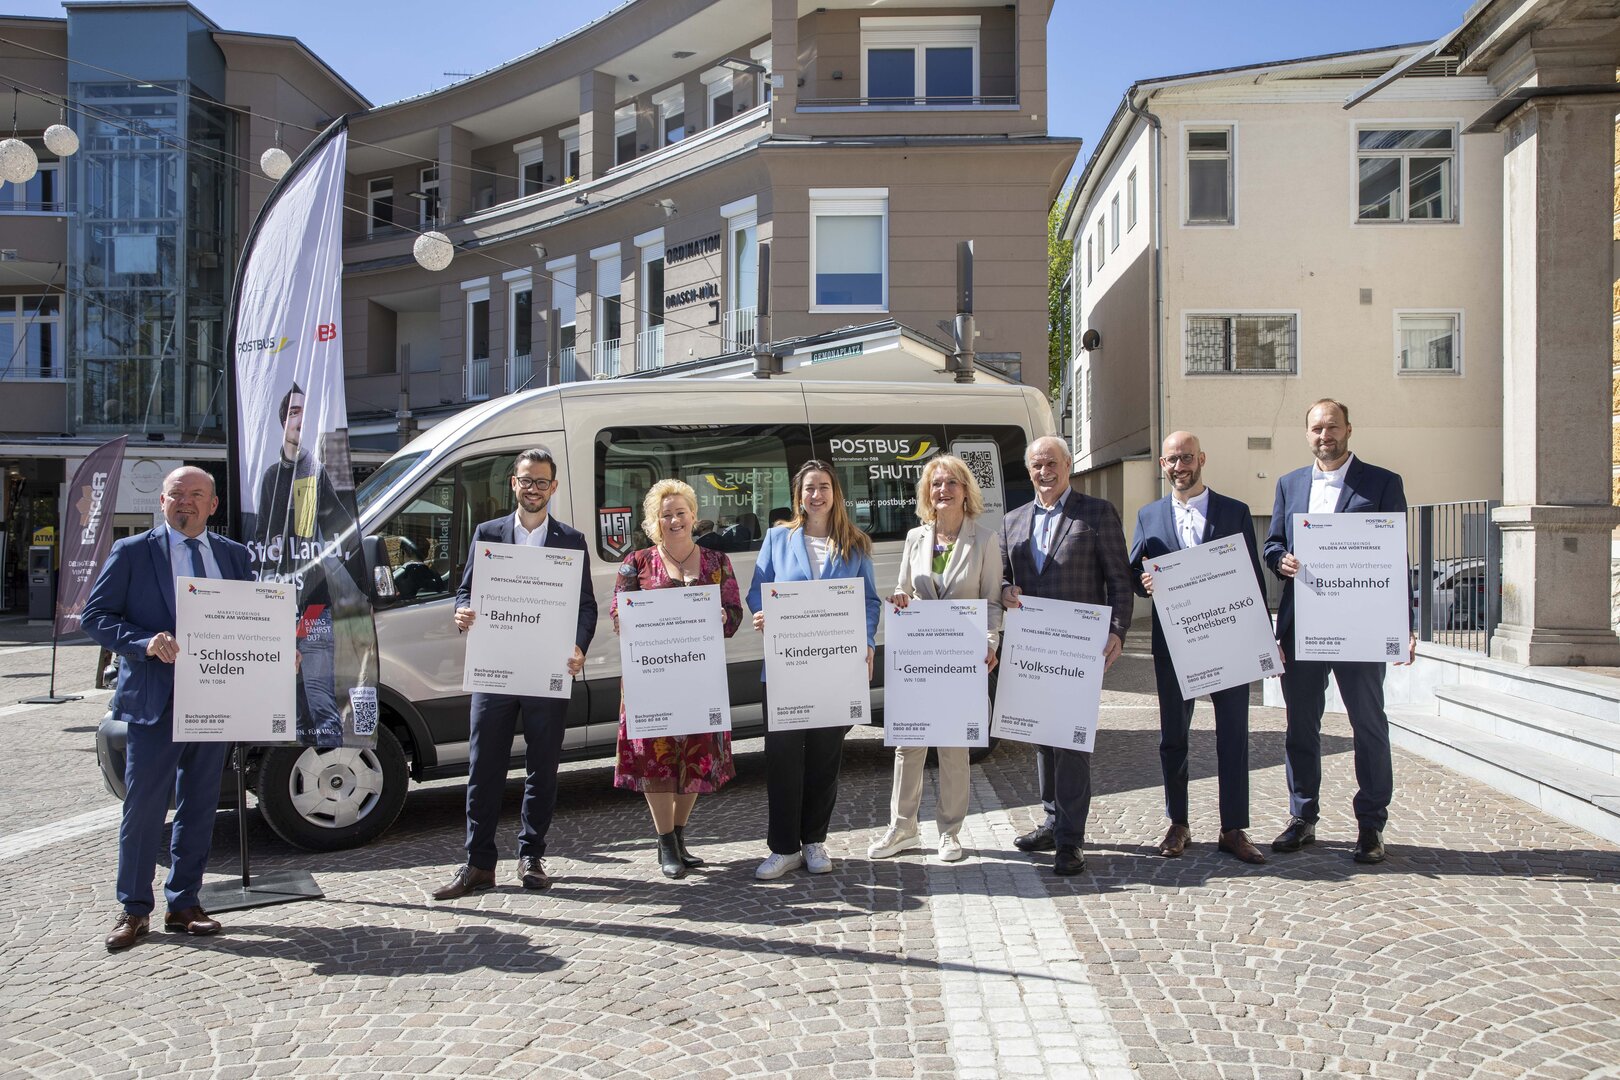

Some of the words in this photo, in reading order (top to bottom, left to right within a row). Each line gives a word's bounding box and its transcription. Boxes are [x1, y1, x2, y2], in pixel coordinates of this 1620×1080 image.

[666, 234, 720, 265] ORDINATION
[314, 323, 336, 342] BB
[238, 337, 275, 354] POSTBUS
[814, 345, 861, 362] GEMONAPLATZ
[830, 439, 910, 454] POSTBUS
[869, 464, 925, 480] SHUTT
[34, 534, 53, 542] ATM
[1209, 544, 1228, 552] POSTBUS
[1219, 547, 1236, 555] SHUTTLE
[1168, 580, 1198, 592] TECHELSBERG
[1207, 569, 1237, 581] WÖRTHERSEE
[1190, 572, 1212, 581] GEMEINDE
[1316, 578, 1390, 589] Busbahnhof
[486, 594, 567, 606] Pörtschach/Wörthersee
[1171, 600, 1191, 611] Sekull
[490, 610, 541, 624] Bahnhof
[1180, 607, 1226, 625] Sportplatz
[1229, 597, 1253, 612] ASKÖ
[1183, 615, 1236, 635] Techelsberg
[238, 633, 281, 642] Wörthersee
[778, 629, 855, 639] Pörtschach/Wörthersee
[1061, 633, 1091, 641] WÖRTHERSEE
[634, 636, 700, 647] Pörtschach/Wörther
[200, 649, 280, 662] Schlosshotel
[785, 644, 857, 658] Kindergarten
[1025, 645, 1046, 654] Martin
[1059, 650, 1096, 662] Techelsberg
[641, 651, 706, 666] Bootshafen
[200, 663, 245, 675] Velden
[904, 664, 977, 674] Gemeindeamt
[1020, 660, 1085, 679] Volksschule
